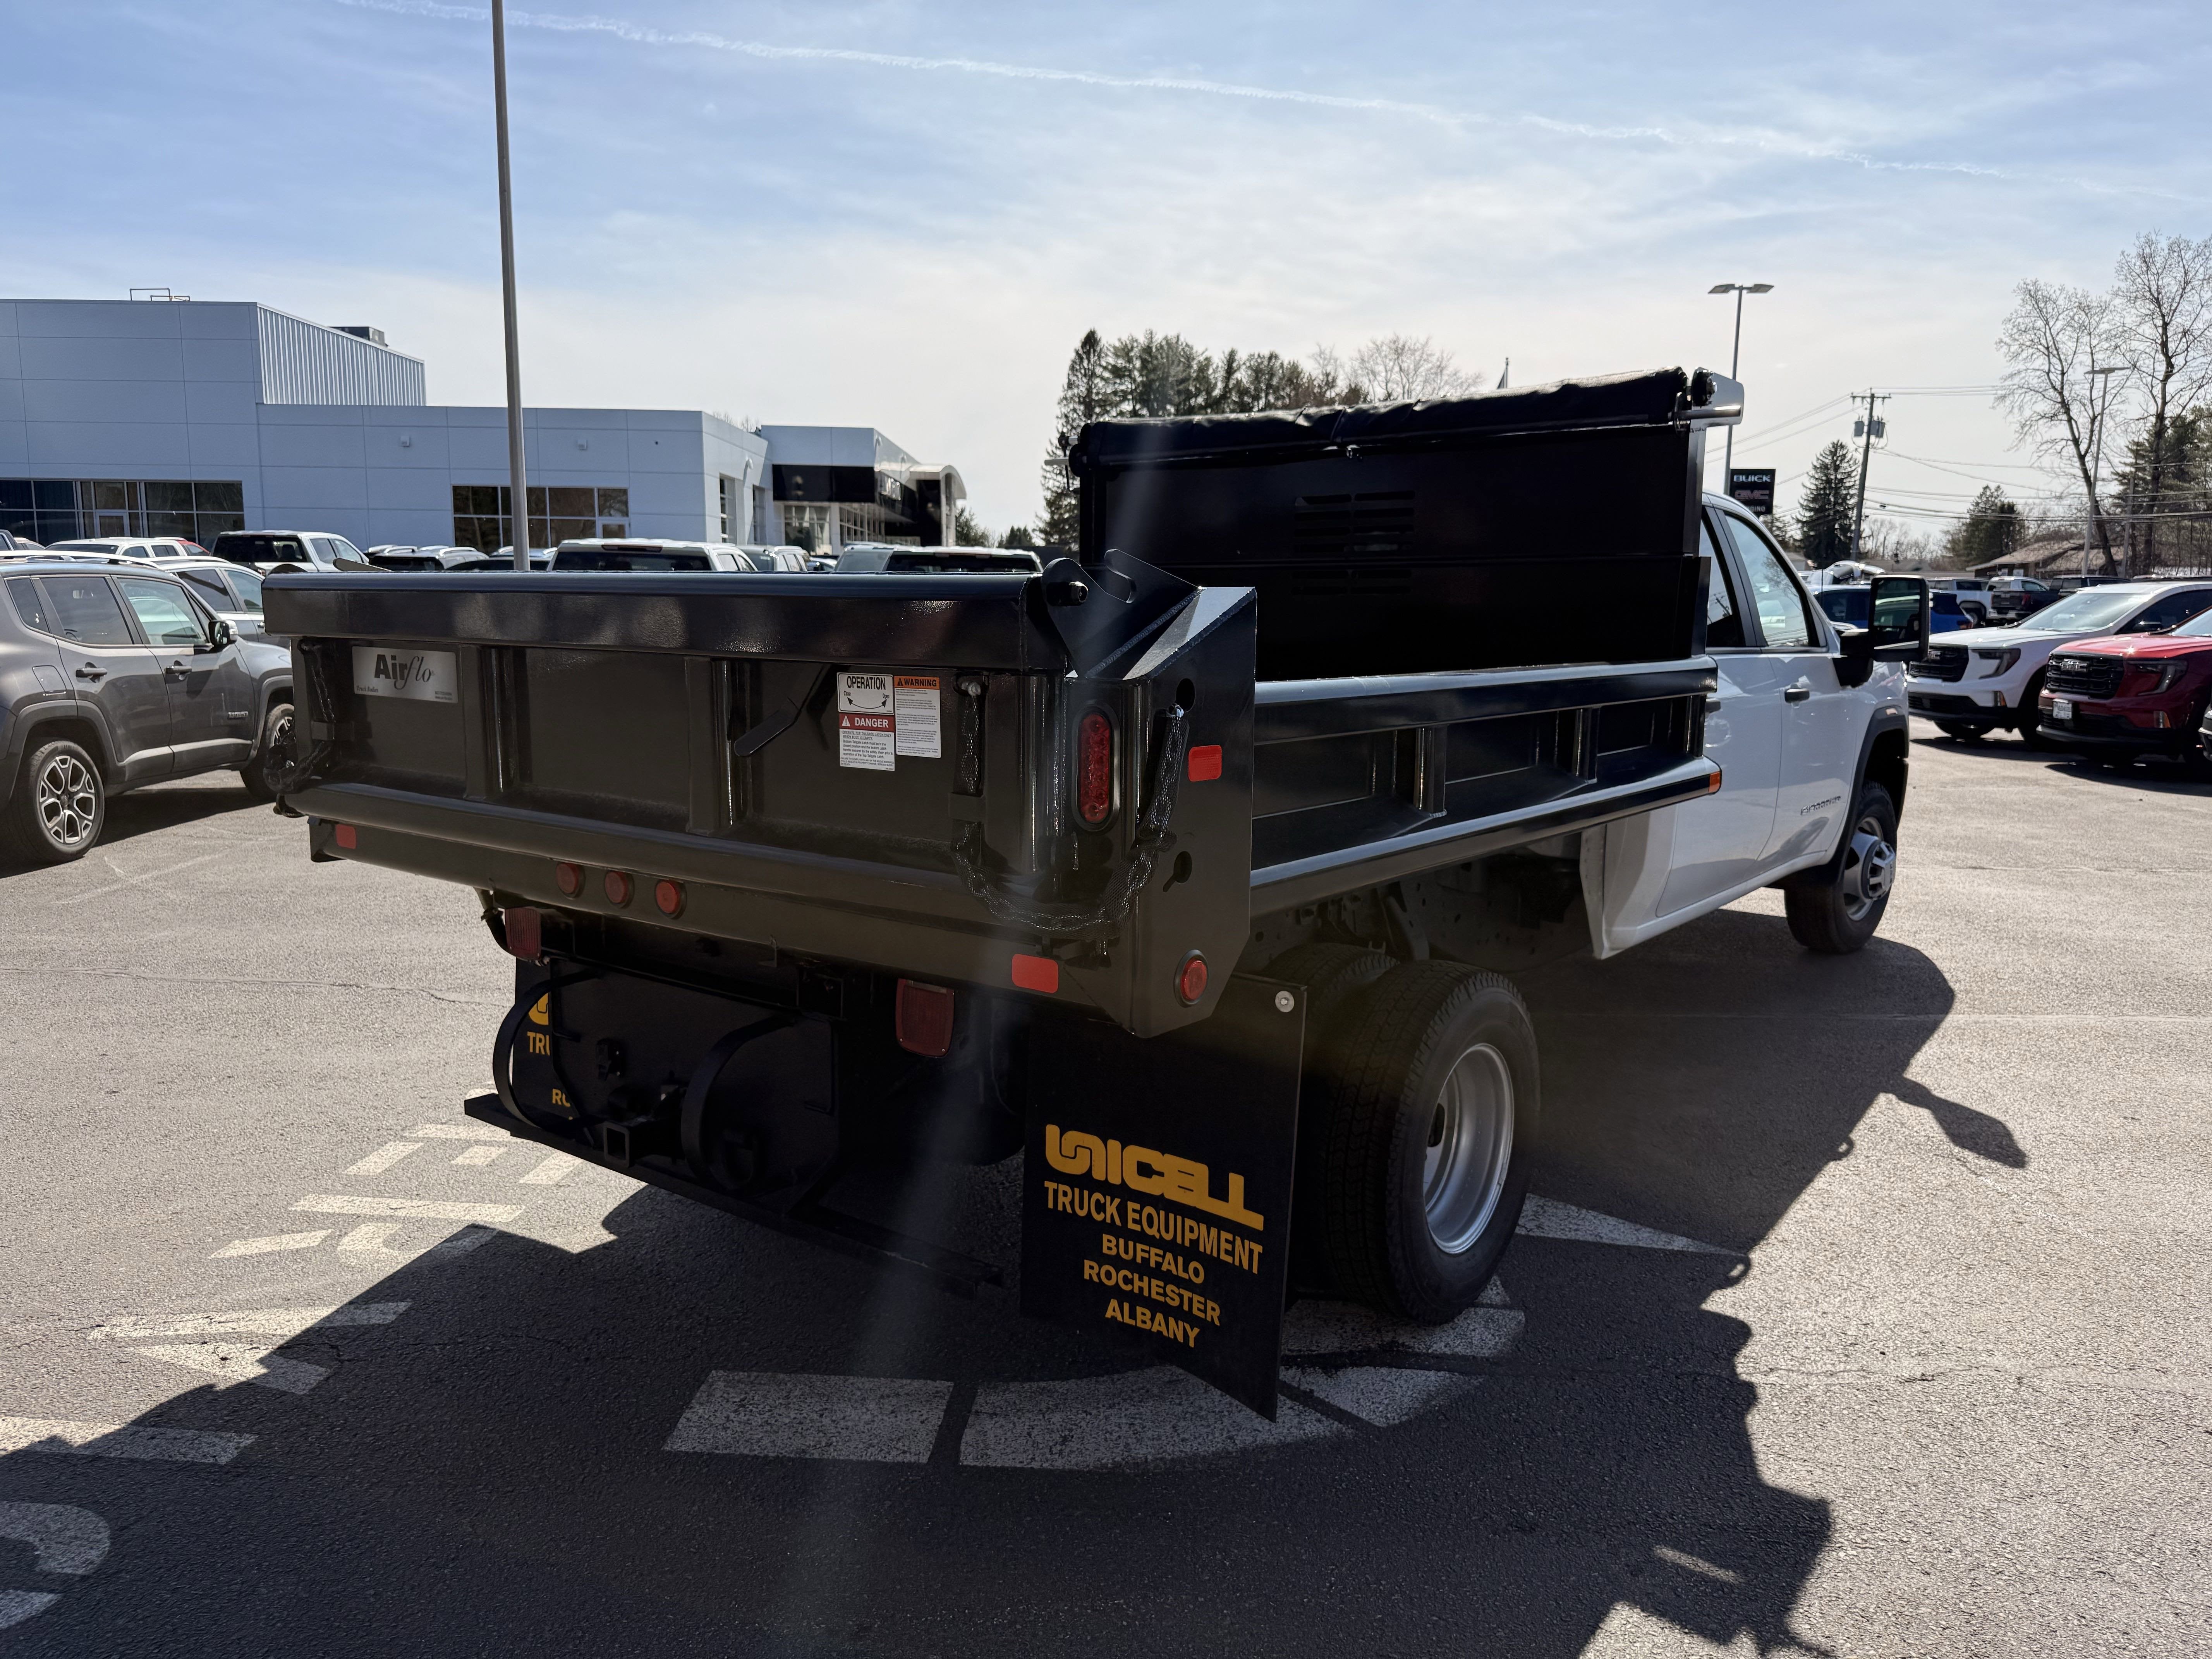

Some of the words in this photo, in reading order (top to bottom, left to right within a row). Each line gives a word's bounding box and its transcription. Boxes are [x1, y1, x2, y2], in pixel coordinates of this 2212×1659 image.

[1735, 490, 1769, 500] GMC
[374, 654, 431, 690] Airflo
[847, 676, 886, 690] OPERATION
[904, 678, 937, 687] WARNING
[2060, 658, 2088, 672] GMC
[855, 718, 889, 728] DANGER
[1045, 1124, 1264, 1231] UNICELL
[1044, 1180, 1121, 1226] TRUCK
[1127, 1200, 1263, 1274] EQUIPMENT
[1102, 1233, 1205, 1284] BUFFALO
[1084, 1259, 1221, 1326] ROCHESTER
[1104, 1298, 1200, 1348] ALBANY
